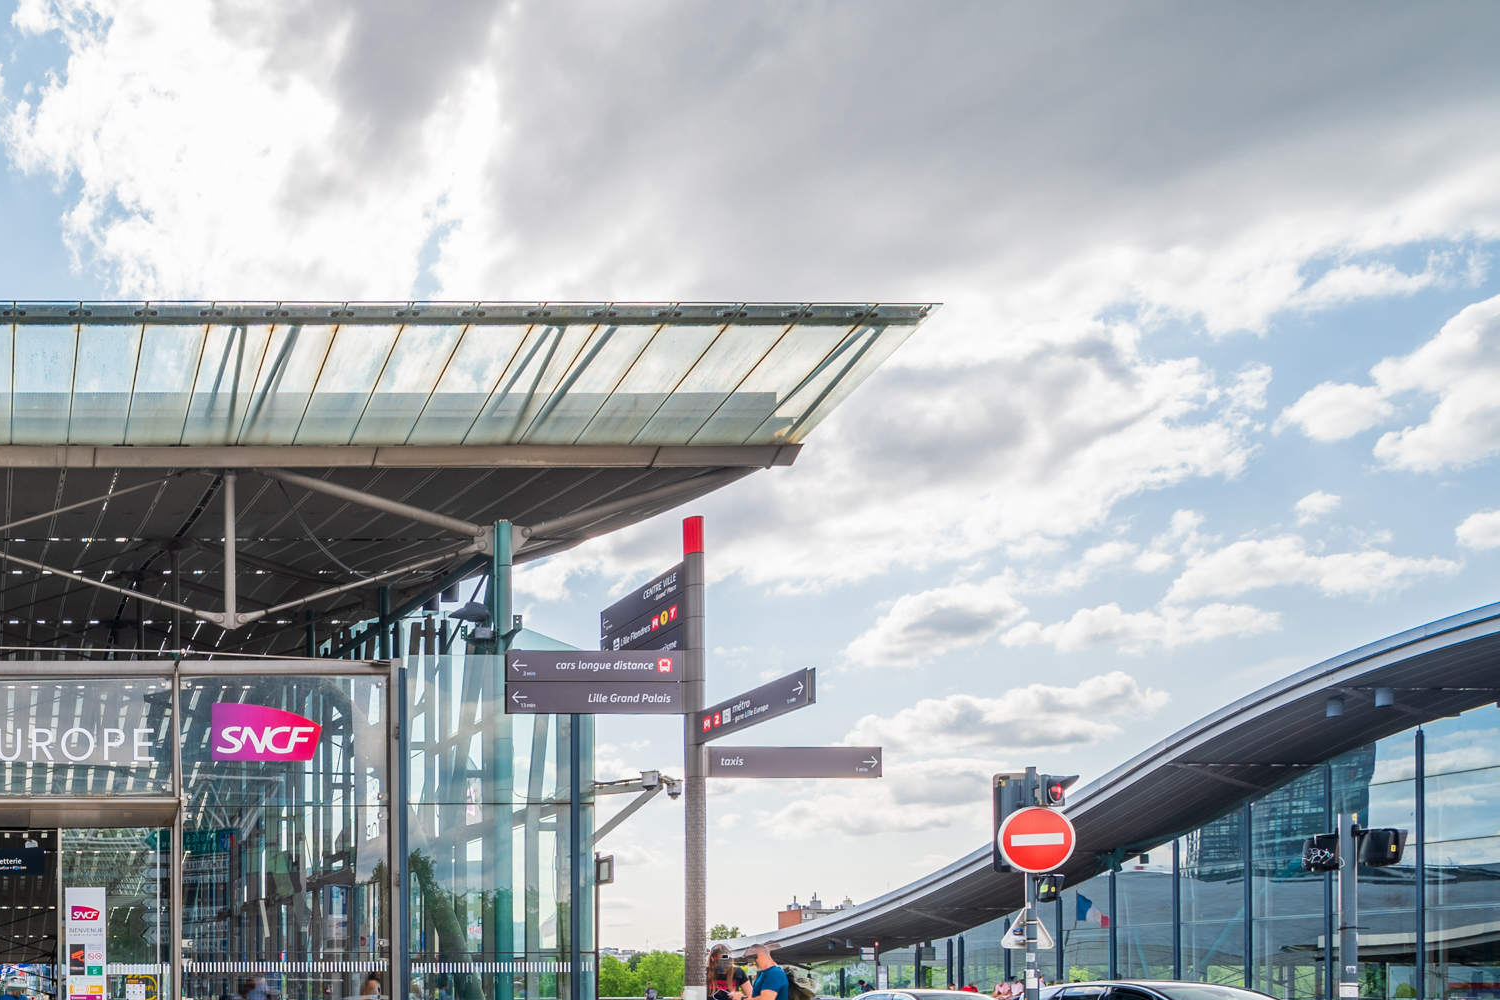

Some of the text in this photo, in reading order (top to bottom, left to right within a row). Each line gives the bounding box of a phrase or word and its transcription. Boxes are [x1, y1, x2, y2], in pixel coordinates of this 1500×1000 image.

[642, 572, 677, 600] CENTRE VILLE
[620, 636, 630, 646] Lille
[630, 624, 650, 641] Flandres
[556, 660, 654, 672] cars longue distance
[588, 694, 671, 703] Lille Grand Palais
[732, 700, 751, 713] métro
[734, 704, 769, 723] gare Lille Europe
[216, 726, 314, 754] SNCF
[720, 756, 744, 766] taxis
[72, 911, 98, 919] SNCF
